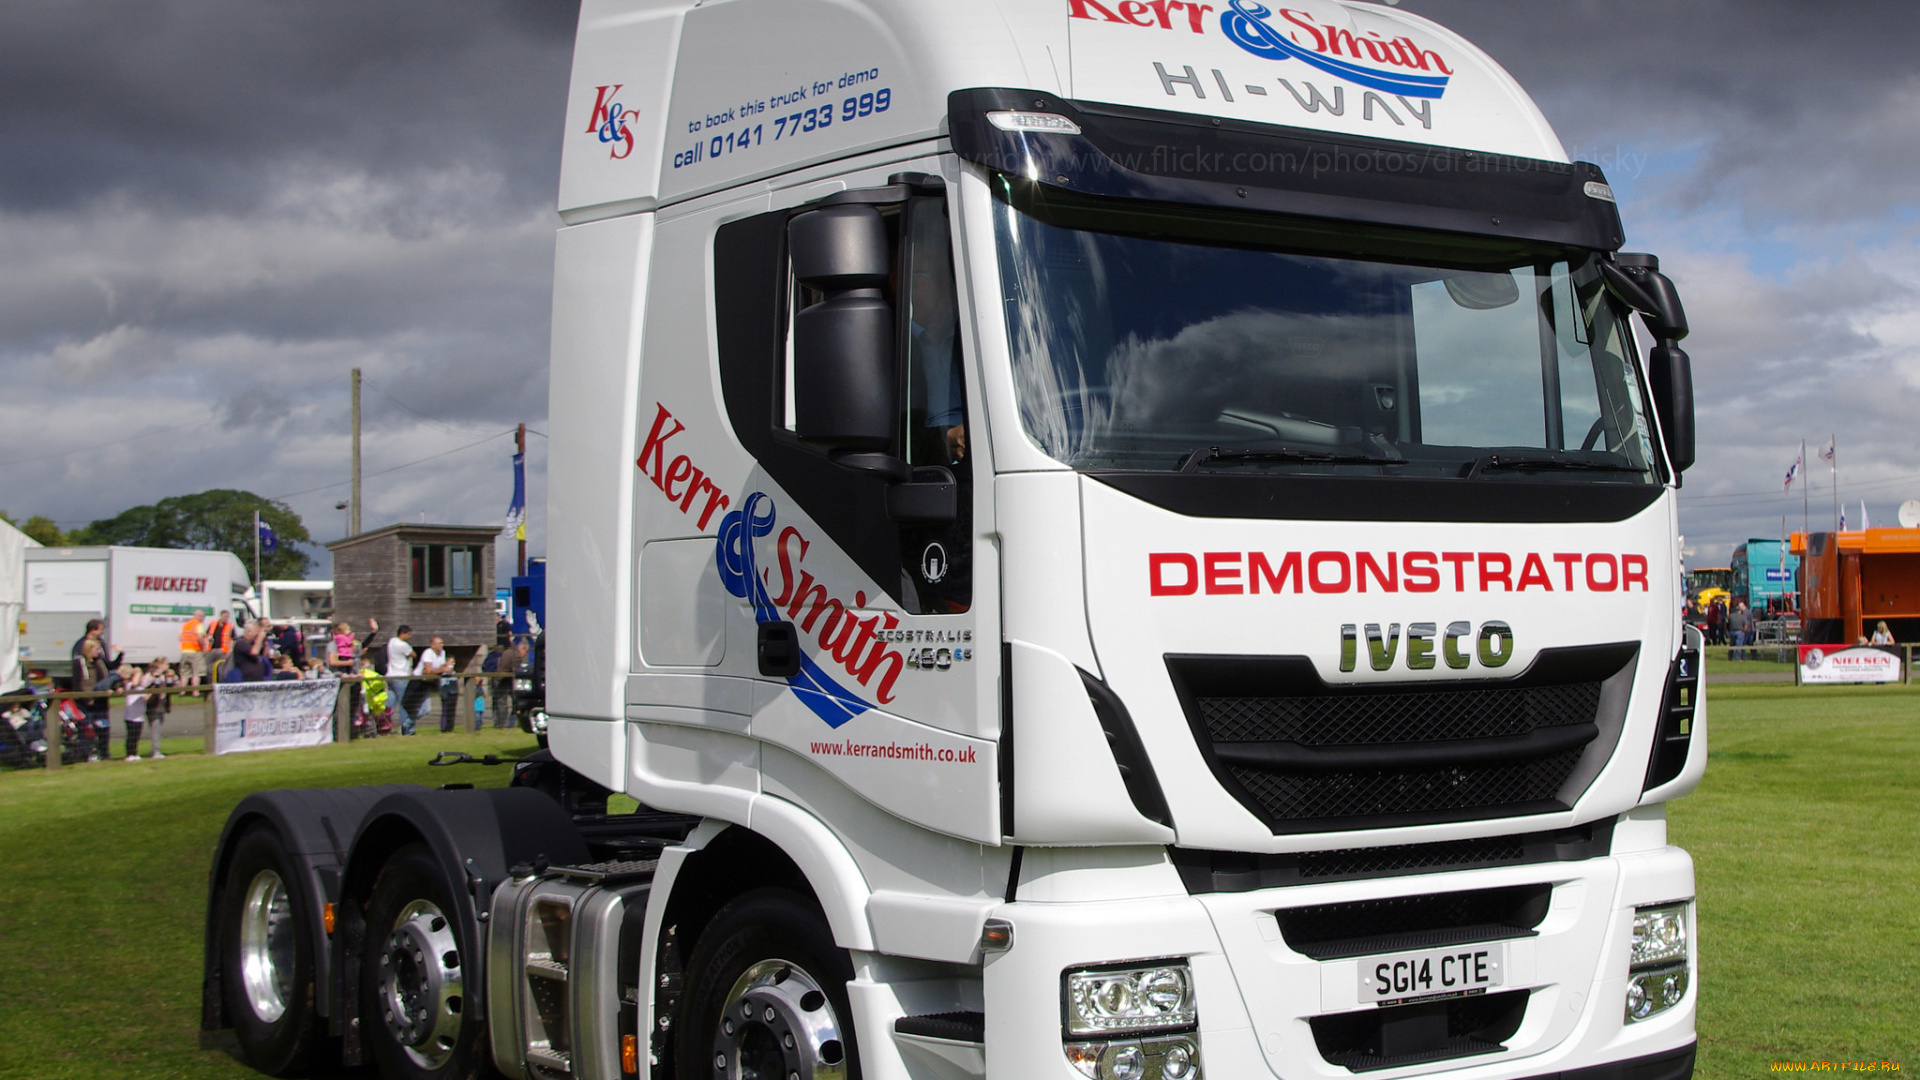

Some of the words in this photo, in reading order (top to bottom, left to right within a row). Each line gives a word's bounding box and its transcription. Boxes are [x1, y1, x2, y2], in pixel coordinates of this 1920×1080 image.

[1279, 8, 1454, 76] Smith
[585, 85, 640, 160] K&S
[688, 120, 702, 134] to
[705, 107, 736, 129] book
[739, 99, 765, 119] this
[769, 85, 807, 109] truck
[811, 80, 833, 98] for
[837, 67, 879, 90] demo
[673, 141, 704, 169] call
[709, 123, 764, 159] 0141
[773, 103, 833, 141] 7733
[841, 87, 891, 123] 999
[636, 401, 730, 532] Kerr
[763, 525, 904, 705] Smith
[1148, 550, 1649, 597] DEMONSTRATOR
[136, 576, 209, 593] TRUCKFEST
[1339, 620, 1514, 673] IVECO
[1831, 657, 1892, 665] NIELSEN
[249, 719, 278, 734] AND
[810, 739, 976, 763] www.kerrandsmith.co.uk
[1375, 957, 1433, 996] SG14
[1441, 950, 1489, 987] CTE
